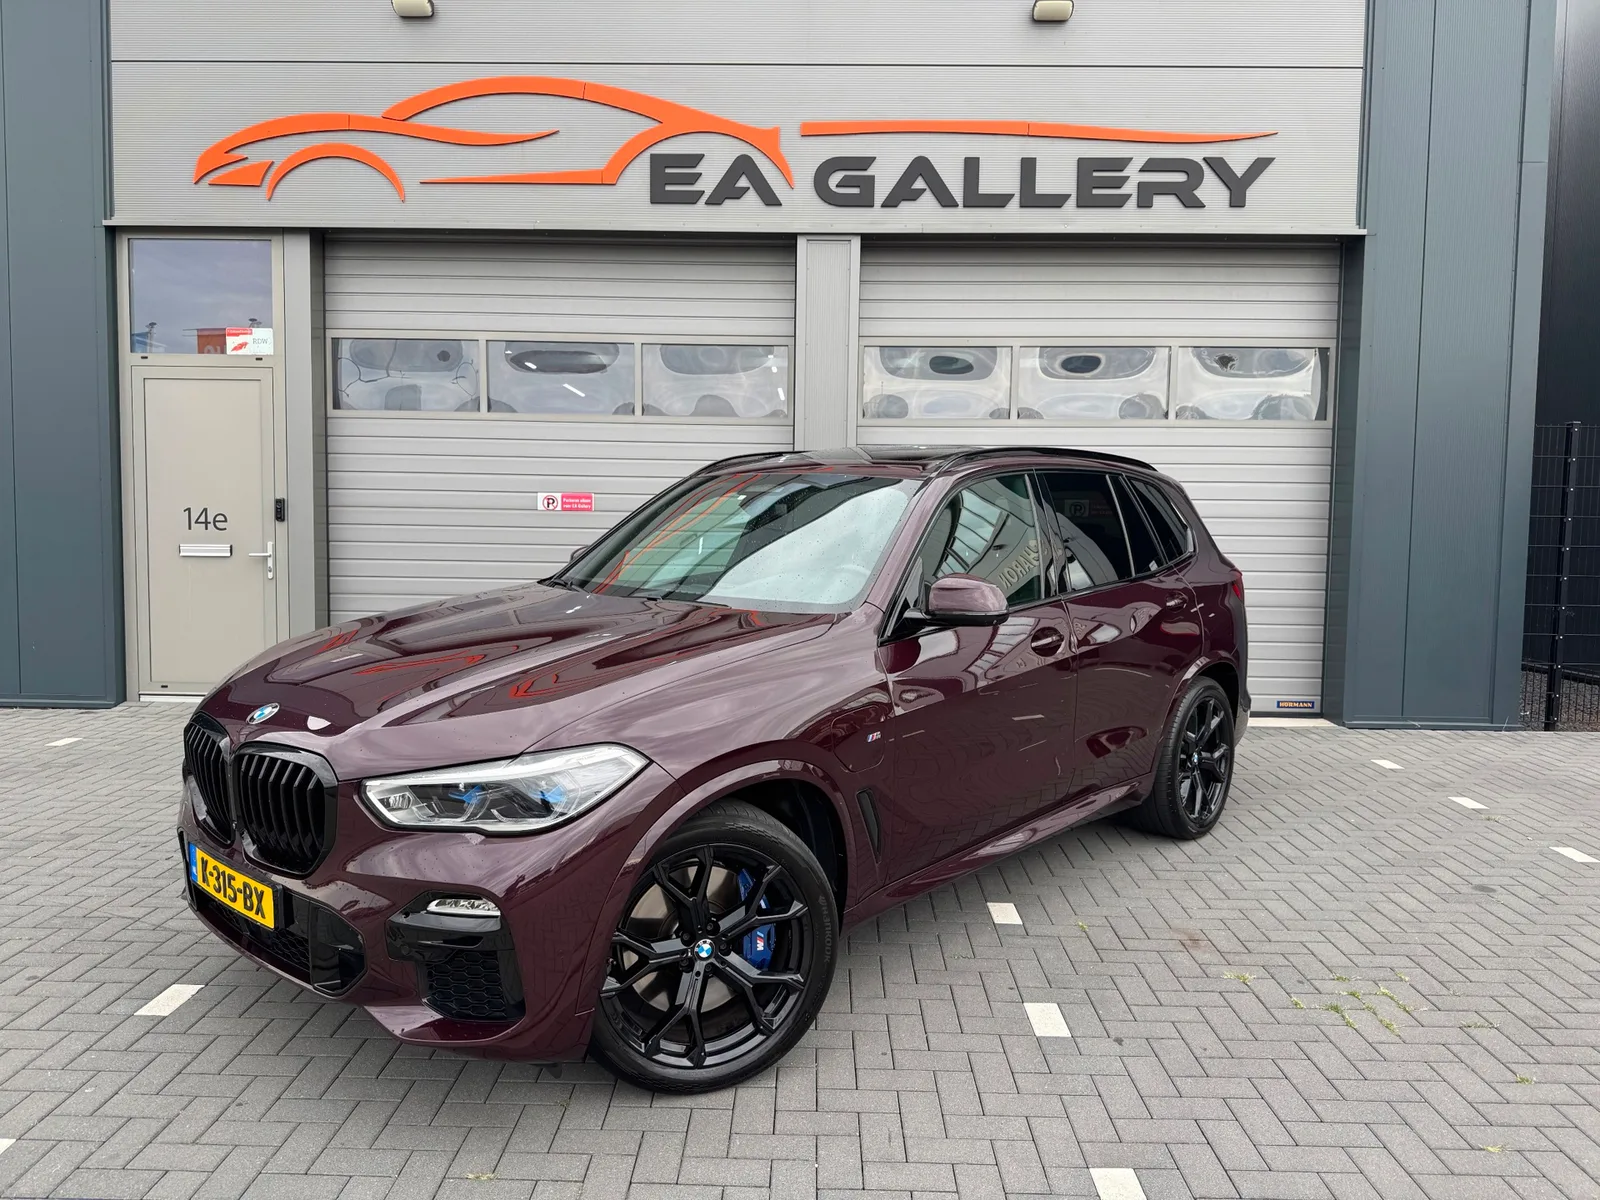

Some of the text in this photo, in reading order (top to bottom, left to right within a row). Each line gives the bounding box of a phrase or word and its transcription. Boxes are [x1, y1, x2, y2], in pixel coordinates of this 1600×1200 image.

[650, 153, 1276, 208] EA GALLERY
[183, 507, 228, 531] 14e
[201, 856, 266, 919] K-315-BX
